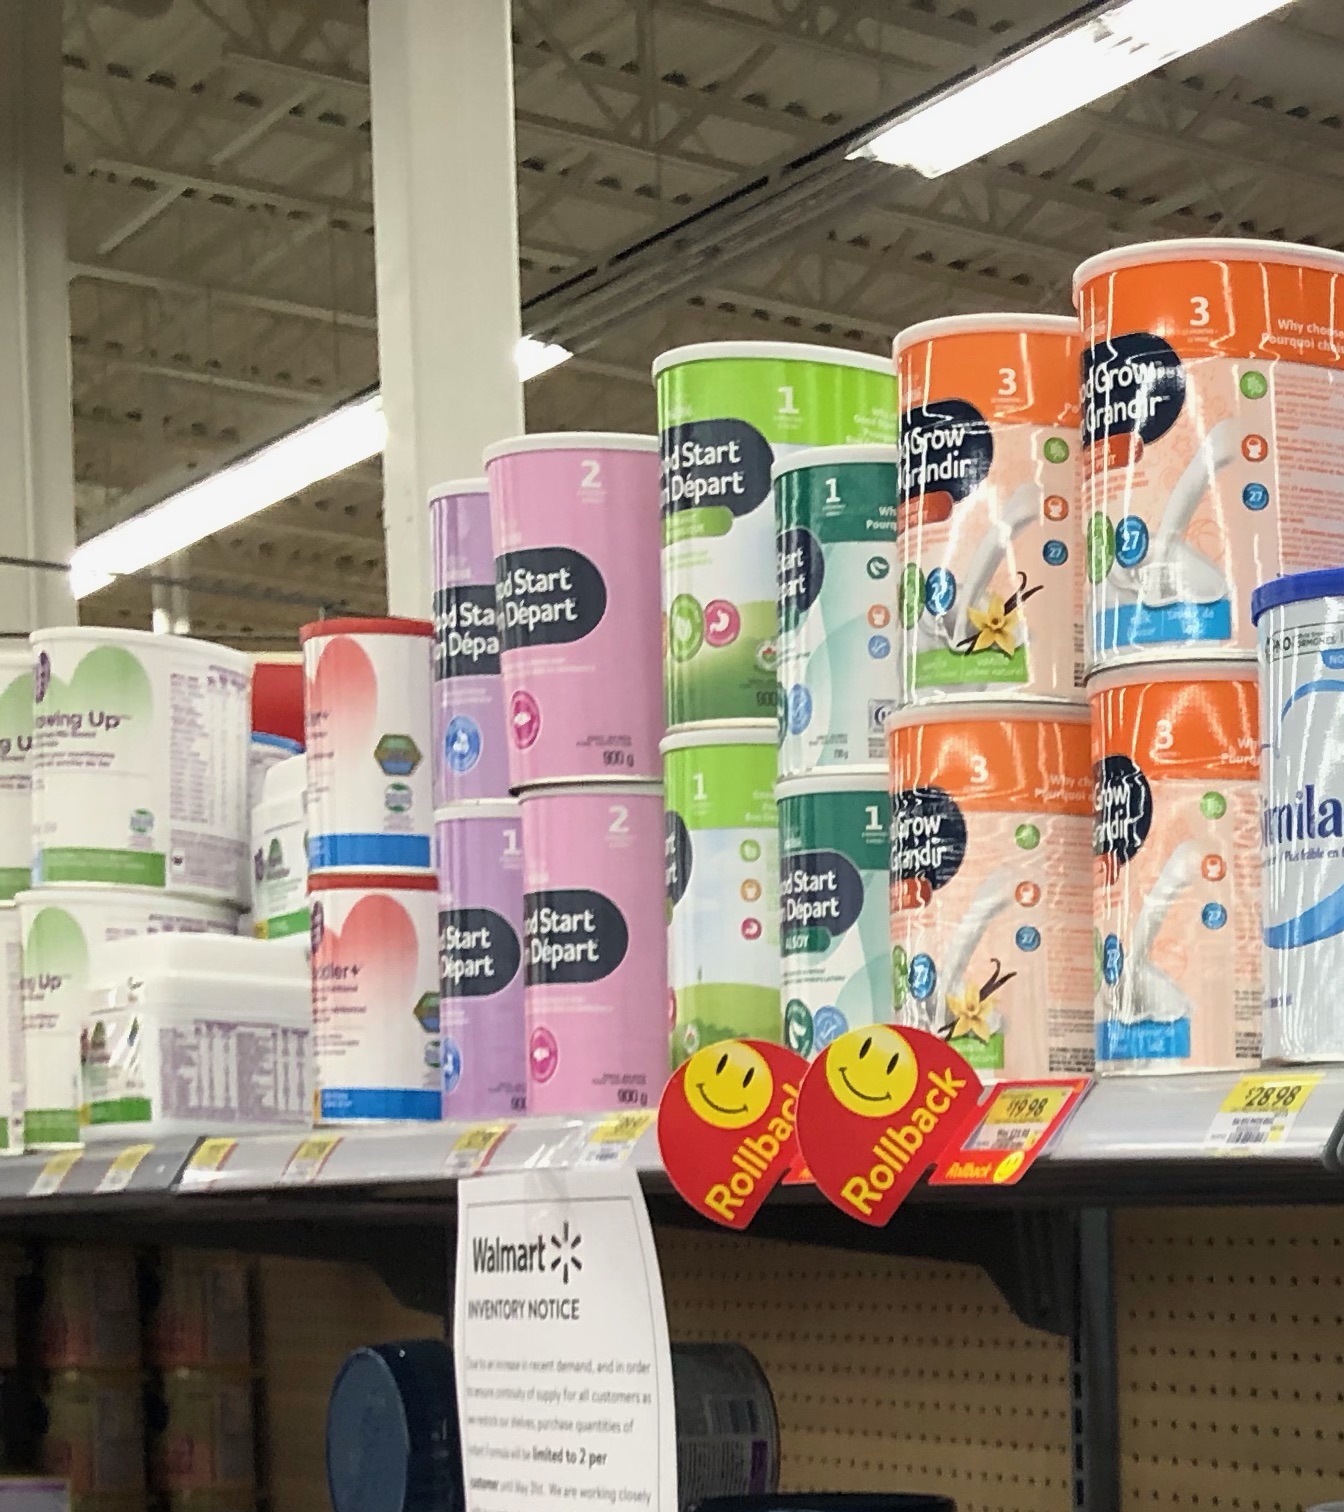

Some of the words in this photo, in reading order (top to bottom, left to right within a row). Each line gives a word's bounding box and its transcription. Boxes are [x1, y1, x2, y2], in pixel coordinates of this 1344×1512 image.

[1190, 296, 1211, 327] 3
[778, 387, 799, 415] 1
[682, 441, 741, 466] Start
[580, 462, 600, 489] 2
[672, 471, 745, 500] Départ
[515, 568, 571, 595] Start
[507, 595, 578, 627] Départ
[1246, 1085, 1296, 1109] $28.98
[841, 1065, 967, 1218] Rollback
[473, 1237, 547, 1274] Walmart
[528, 1299, 579, 1320] NOTICE
